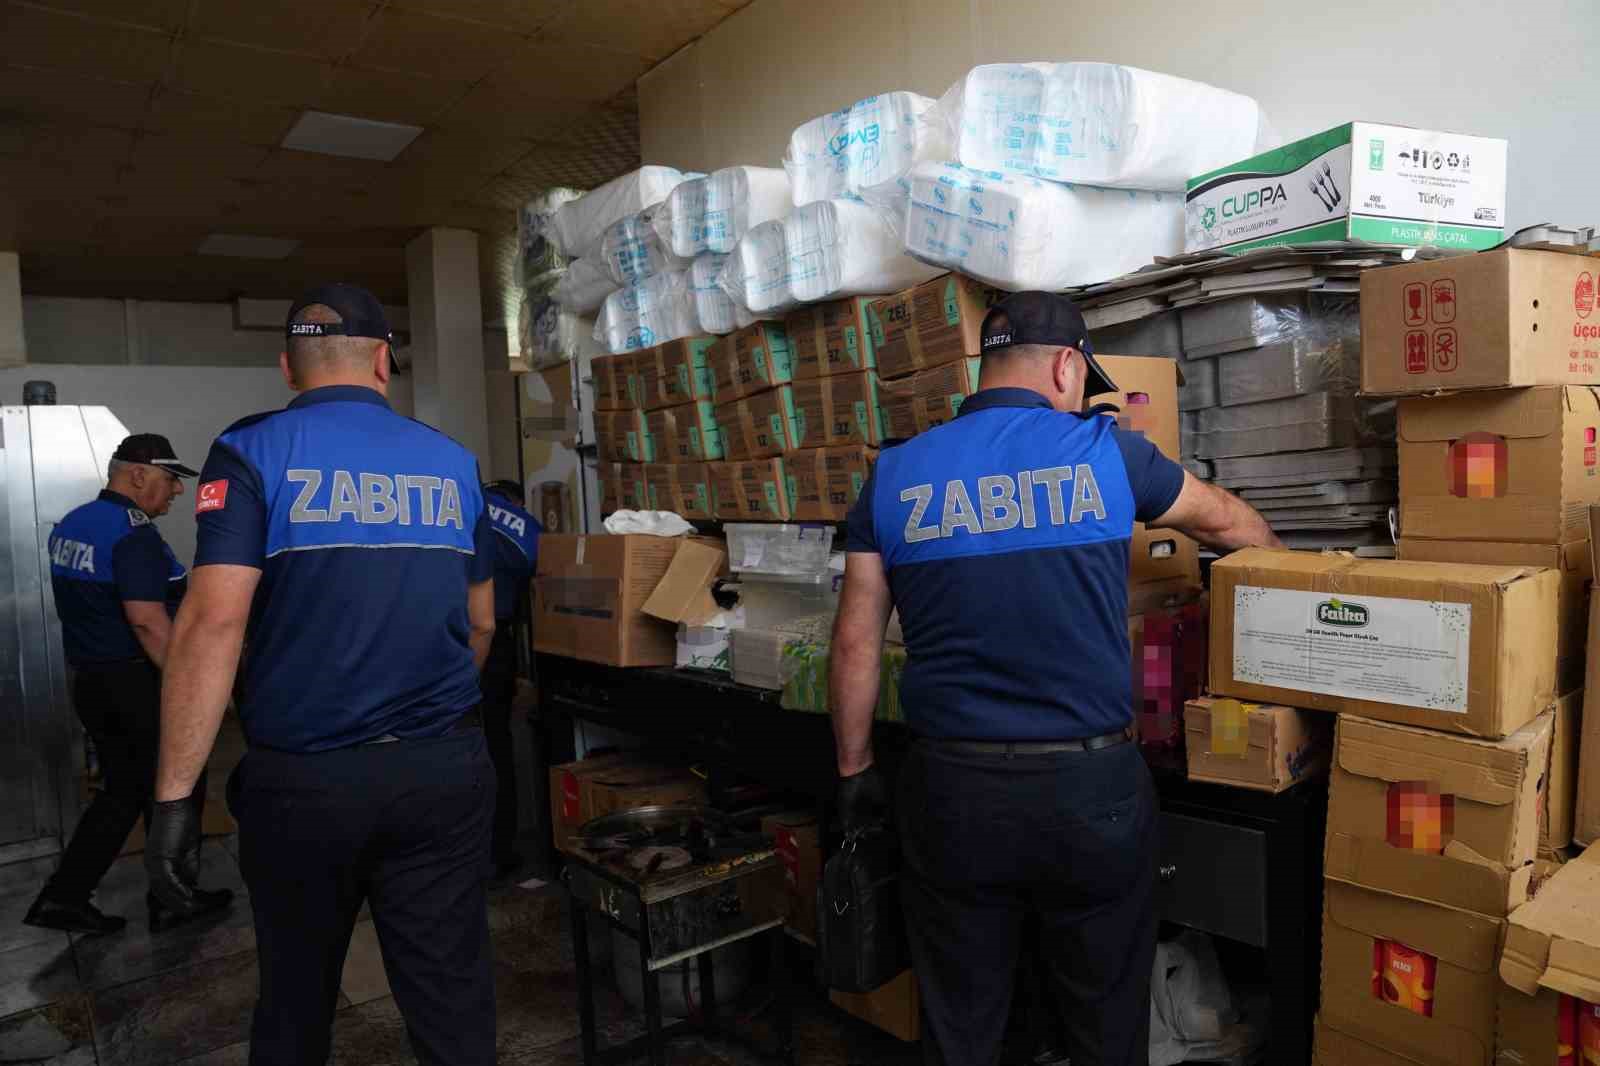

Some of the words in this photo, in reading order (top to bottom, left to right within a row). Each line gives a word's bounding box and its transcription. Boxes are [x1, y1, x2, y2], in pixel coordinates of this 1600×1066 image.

[1222, 183, 1288, 218] CUPPA
[1572, 321, 1600, 341] ÜÇG
[286, 469, 464, 530] ZABITA
[900, 463, 1107, 544] ZABITA
